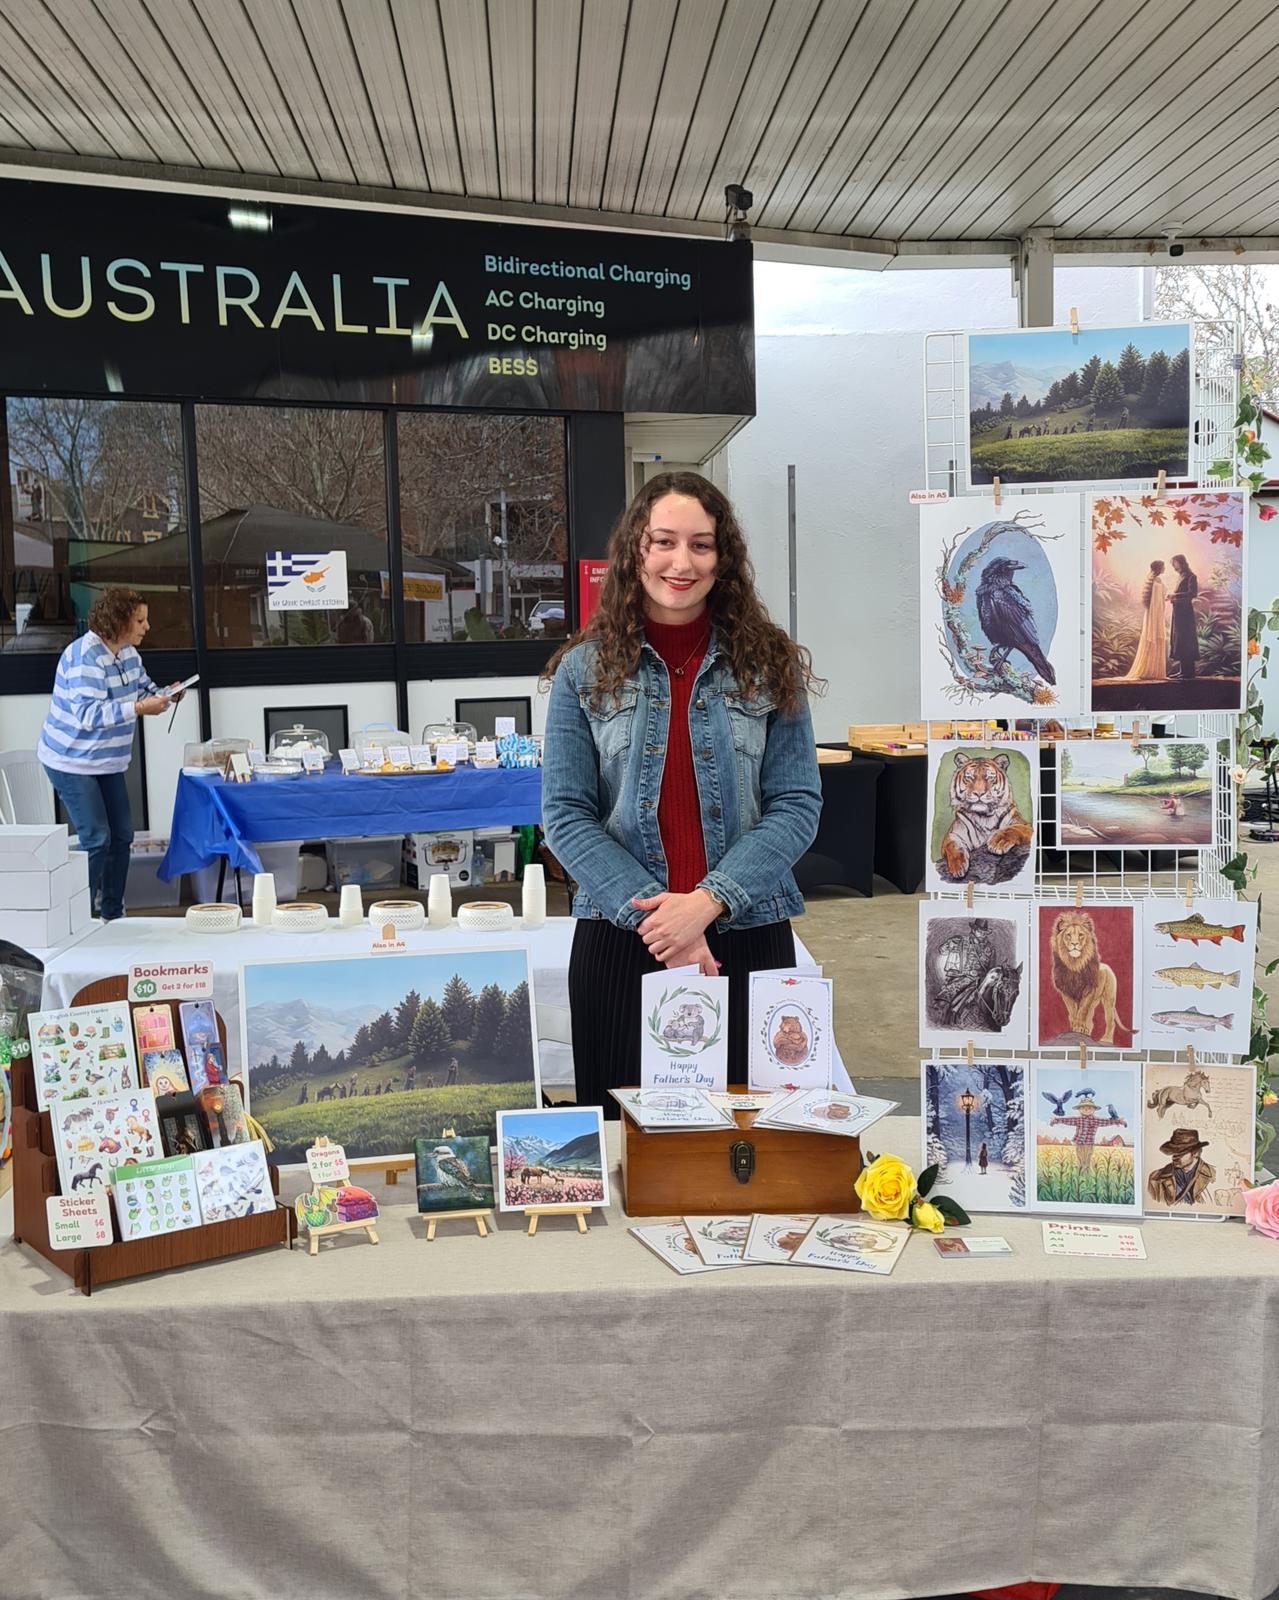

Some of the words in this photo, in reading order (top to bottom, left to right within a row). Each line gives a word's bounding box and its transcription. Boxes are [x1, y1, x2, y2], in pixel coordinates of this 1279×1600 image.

[484, 254, 605, 280] Bidirectional
[609, 264, 691, 291] Charging
[0, 253, 469, 339] AUSTRALIA
[484, 290, 514, 308] AC
[519, 291, 605, 319] Charging
[487, 323, 516, 342] DC
[521, 325, 607, 351] Charging
[488, 356, 538, 377] BESS
[134, 964, 208, 978] Bookmarks
[136, 984, 154, 994] $10
[161, 982, 175, 990] Get
[182, 982, 194, 990] for
[11, 1041, 30, 1057] $10
[670, 1061, 698, 1074] Happy
[653, 1074, 690, 1085] Father's
[696, 1073, 715, 1087] Day
[310, 1149, 340, 1158] Dragons
[312, 1162, 318, 1170] 2
[320, 1160, 333, 1169] for
[334, 1159, 344, 1167] $5
[59, 1198, 96, 1208] Sticker
[62, 1207, 98, 1217] Sheets
[55, 1220, 80, 1230] Small
[94, 1218, 105, 1227] $6
[1048, 1223, 1100, 1232] Prints
[56, 1233, 82, 1243] Large
[95, 1231, 106, 1240] $8
[829, 1250, 862, 1261] Happy
[856, 1259, 878, 1270] Day
